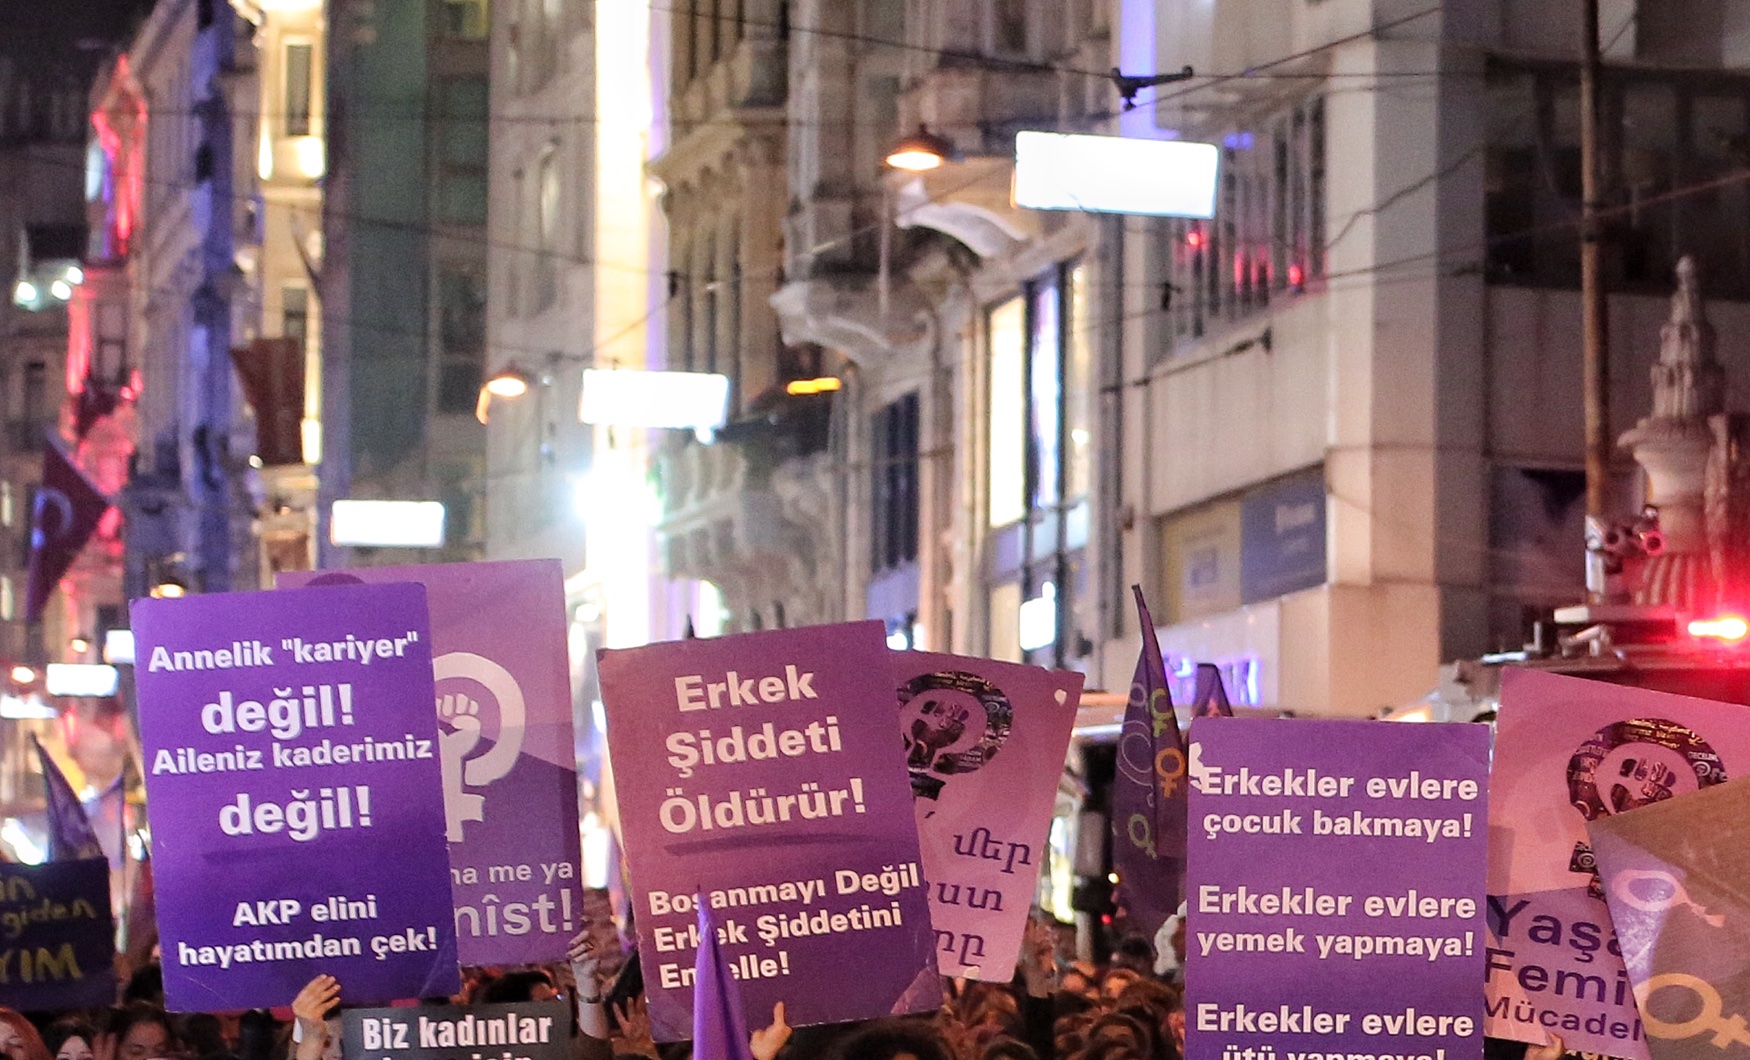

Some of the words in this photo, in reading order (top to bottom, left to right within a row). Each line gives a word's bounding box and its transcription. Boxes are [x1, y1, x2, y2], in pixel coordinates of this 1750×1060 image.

[149, 641, 273, 672] Annelik
[282, 631, 418, 664] "kariyer"
[675, 665, 817, 711] Erkek
[202, 684, 353, 739] değil!
[152, 745, 263, 774] Aileniz
[273, 734, 432, 767] kaderimiz
[666, 716, 841, 778] Şiddeti
[1200, 766, 1354, 798] Erkekler
[1367, 771, 1477, 800] evlere
[220, 786, 371, 841] değil!
[660, 778, 865, 833] Öldürür!
[1204, 810, 1302, 839] çocuk
[1314, 810, 1472, 842] bakmaya!
[489, 865, 531, 882] me
[540, 863, 572, 884] ya
[835, 862, 920, 896] Değil
[233, 900, 300, 926] AKP
[311, 895, 377, 921] elini
[1200, 886, 1352, 915] Erkekler
[1365, 890, 1475, 918] evlere
[757, 902, 901, 946] Şiddetini
[178, 934, 361, 968] hayatımdan
[371, 927, 436, 960] çek!
[1197, 928, 1304, 955] yemek
[1316, 932, 1473, 960] yapmaya!
[363, 1018, 408, 1049] Biz
[419, 1013, 551, 1047] kadınlar
[1198, 1004, 1350, 1033] Erkekler
[1363, 1008, 1473, 1036] evlere
